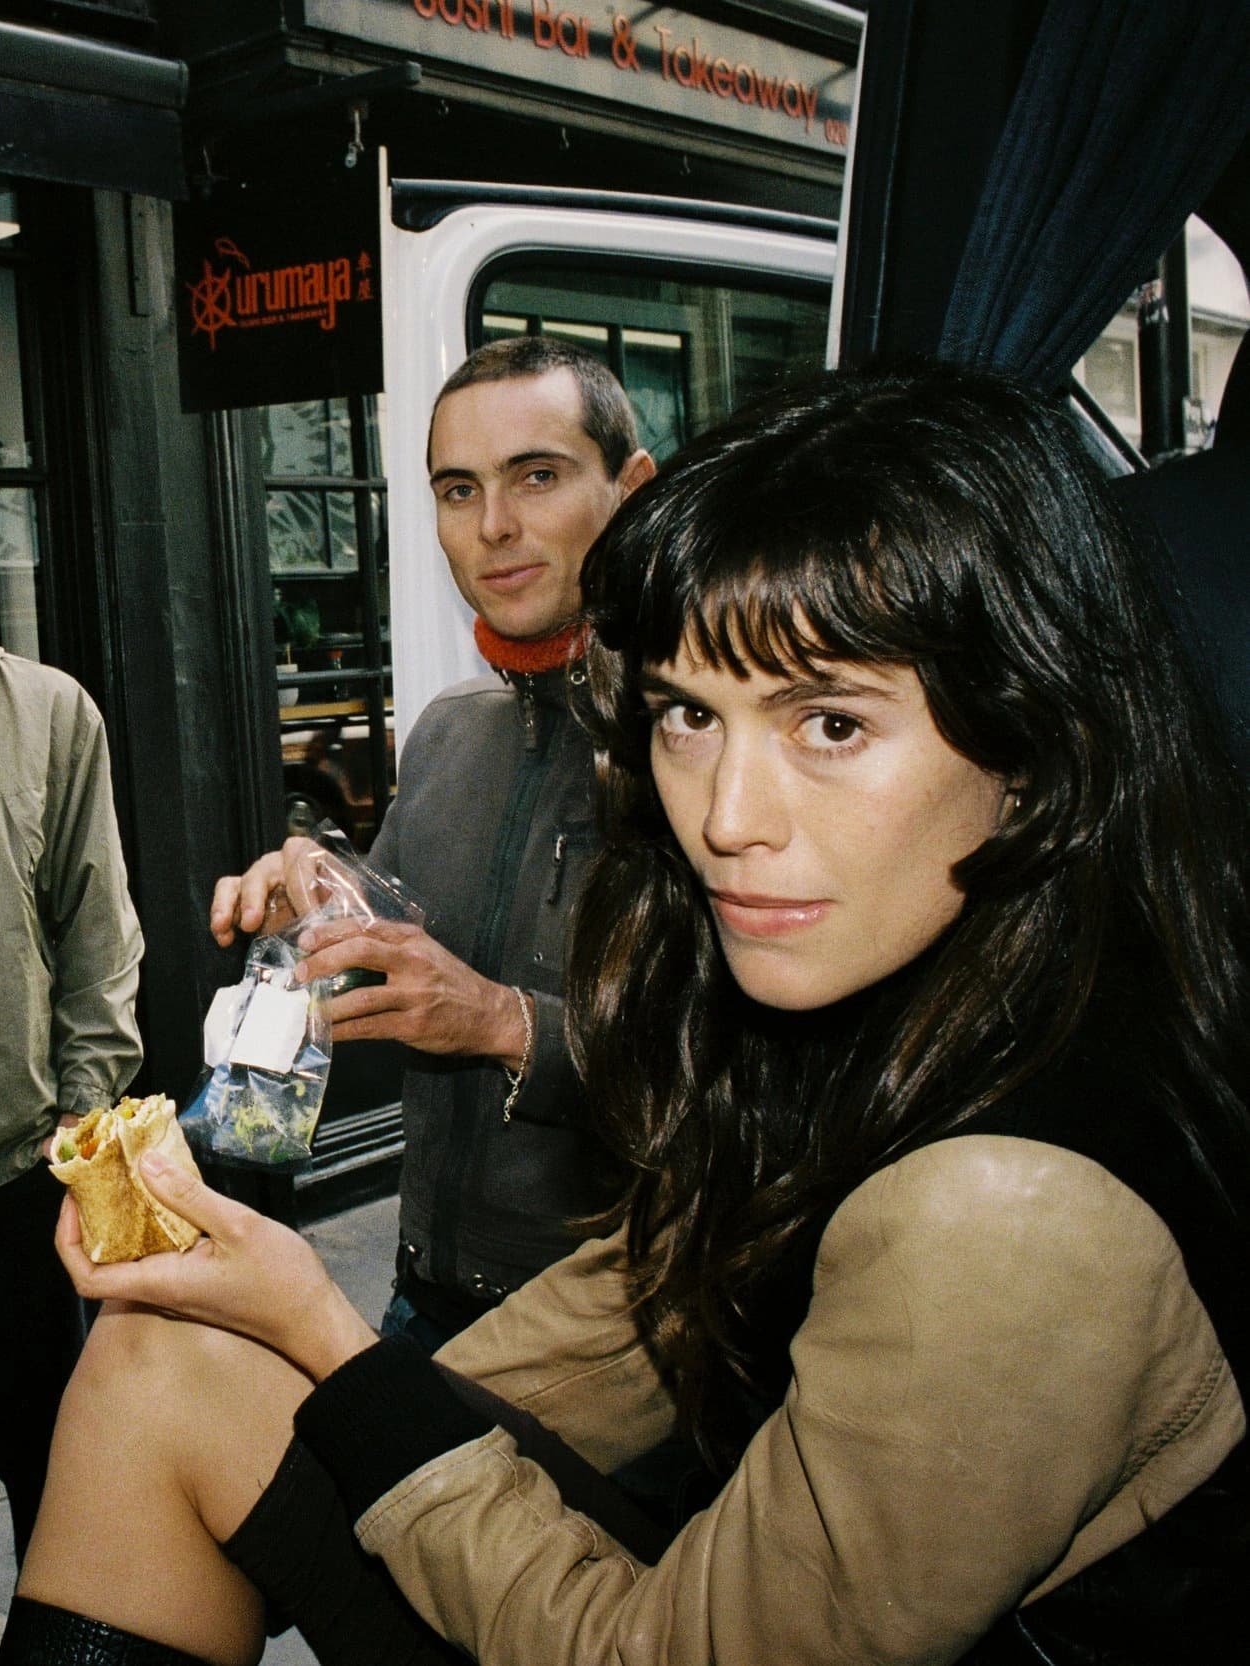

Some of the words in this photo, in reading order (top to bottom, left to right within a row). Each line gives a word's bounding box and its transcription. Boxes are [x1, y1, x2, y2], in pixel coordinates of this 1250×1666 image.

[533, 0, 589, 59] Bar
[612, 14, 641, 73] &
[654, 25, 818, 134] Takeaway
